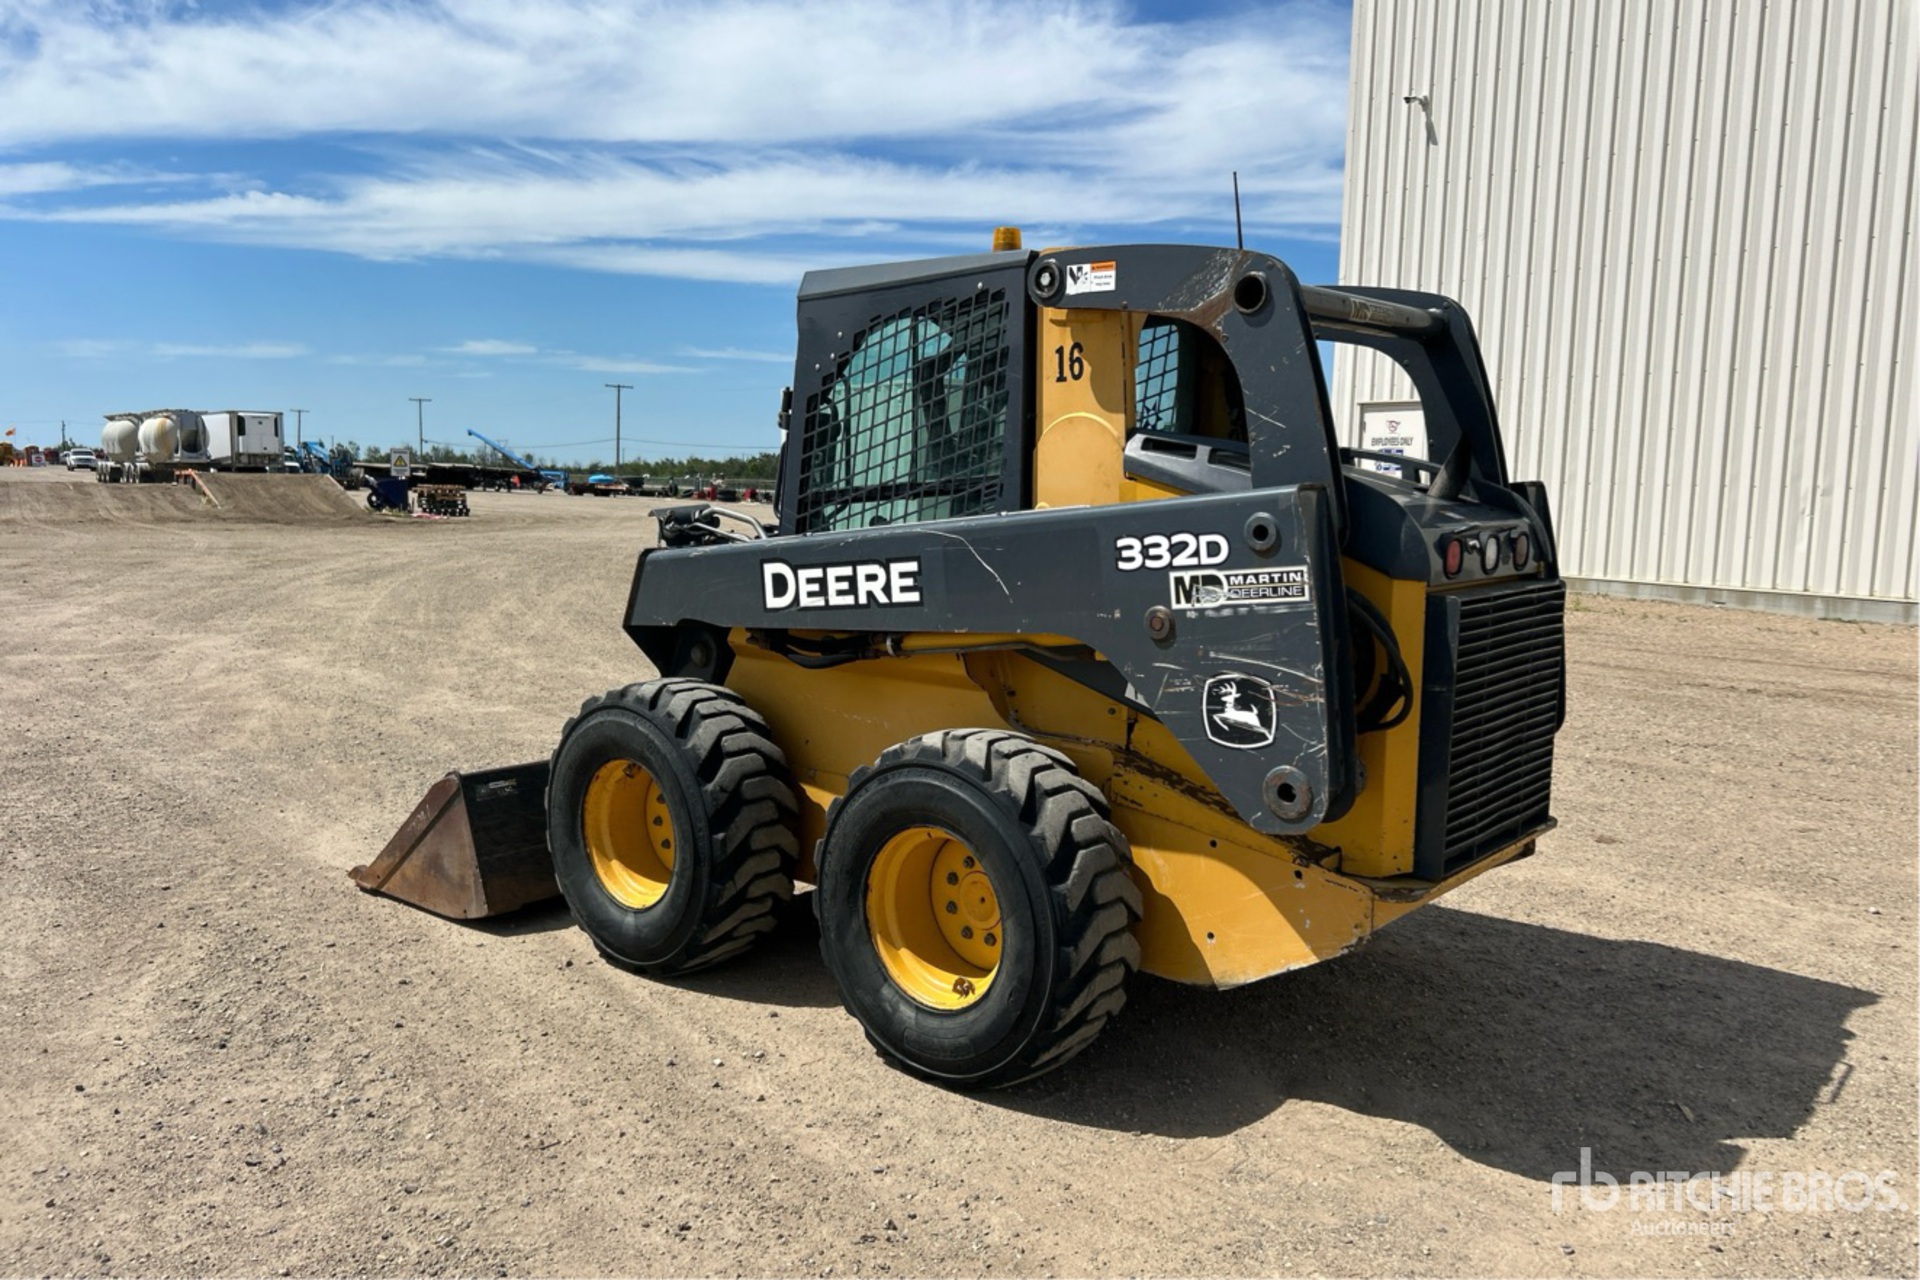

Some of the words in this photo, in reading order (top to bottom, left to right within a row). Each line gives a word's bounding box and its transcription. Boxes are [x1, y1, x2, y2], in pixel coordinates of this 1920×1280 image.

[1055, 342, 1084, 382] 16
[1400, 436, 1414, 446] ONLY
[1115, 532, 1230, 571] 332D
[762, 559, 922, 609] DEERE
[1229, 571, 1302, 586] MARTIN
[1229, 585, 1303, 599] DEERLINE
